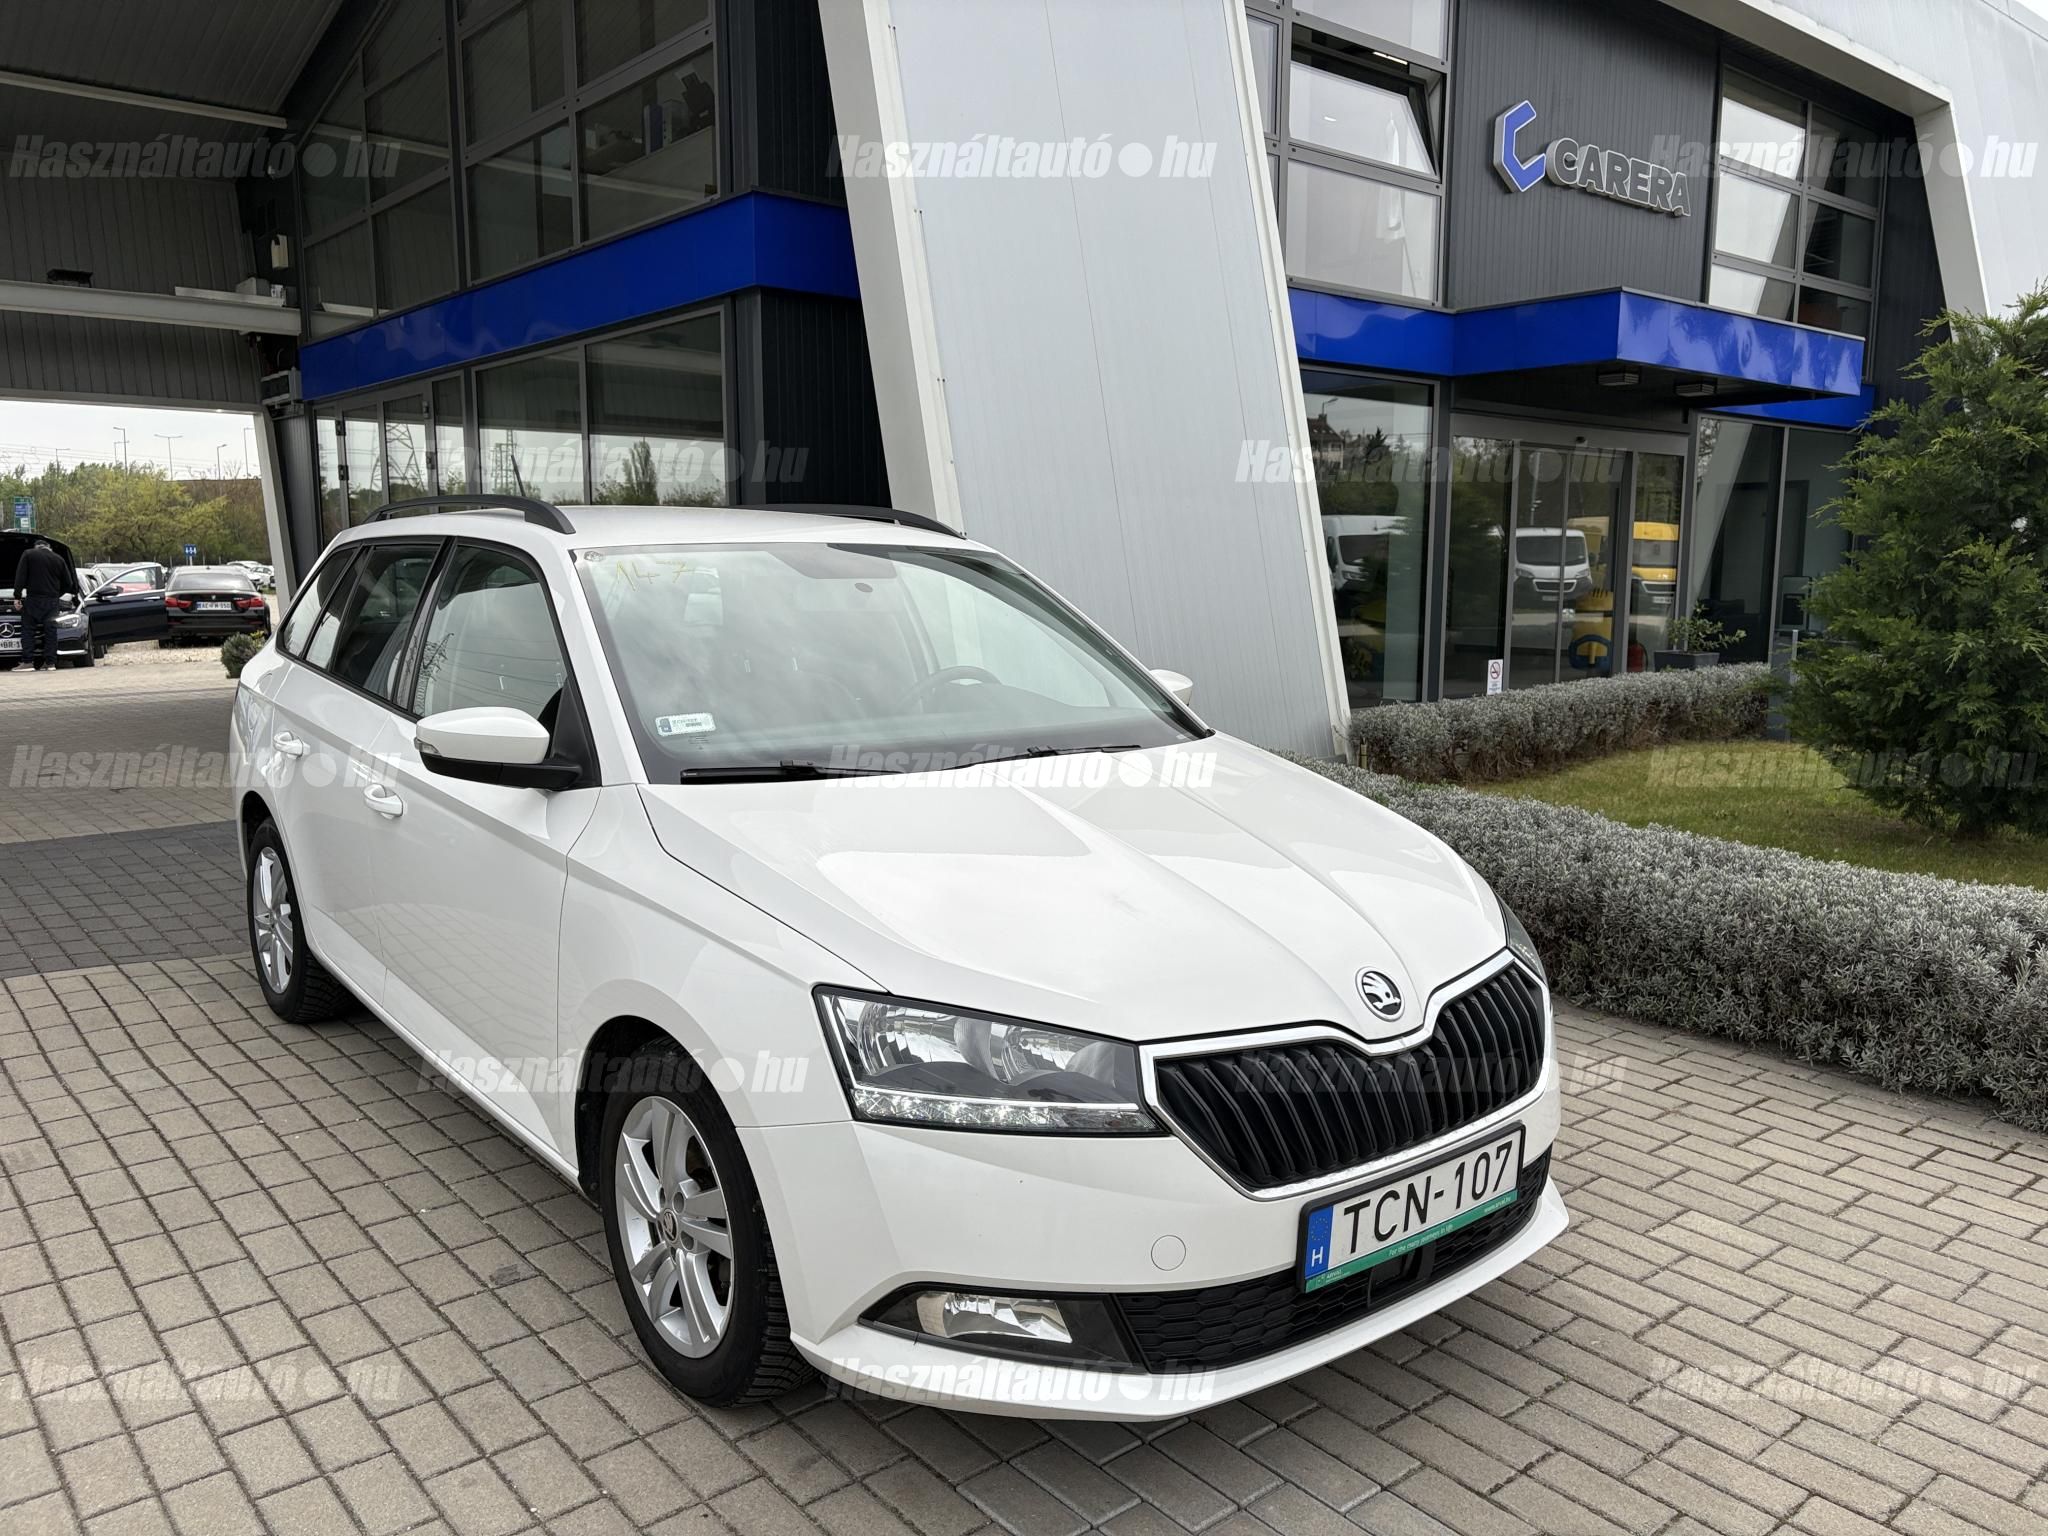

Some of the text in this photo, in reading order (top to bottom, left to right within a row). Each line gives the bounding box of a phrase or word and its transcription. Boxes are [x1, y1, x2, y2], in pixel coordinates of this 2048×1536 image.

[1546, 137, 1692, 218] CARERA
[1343, 1140, 1513, 1254] TCN-107
[1311, 1246, 1324, 1267] H
